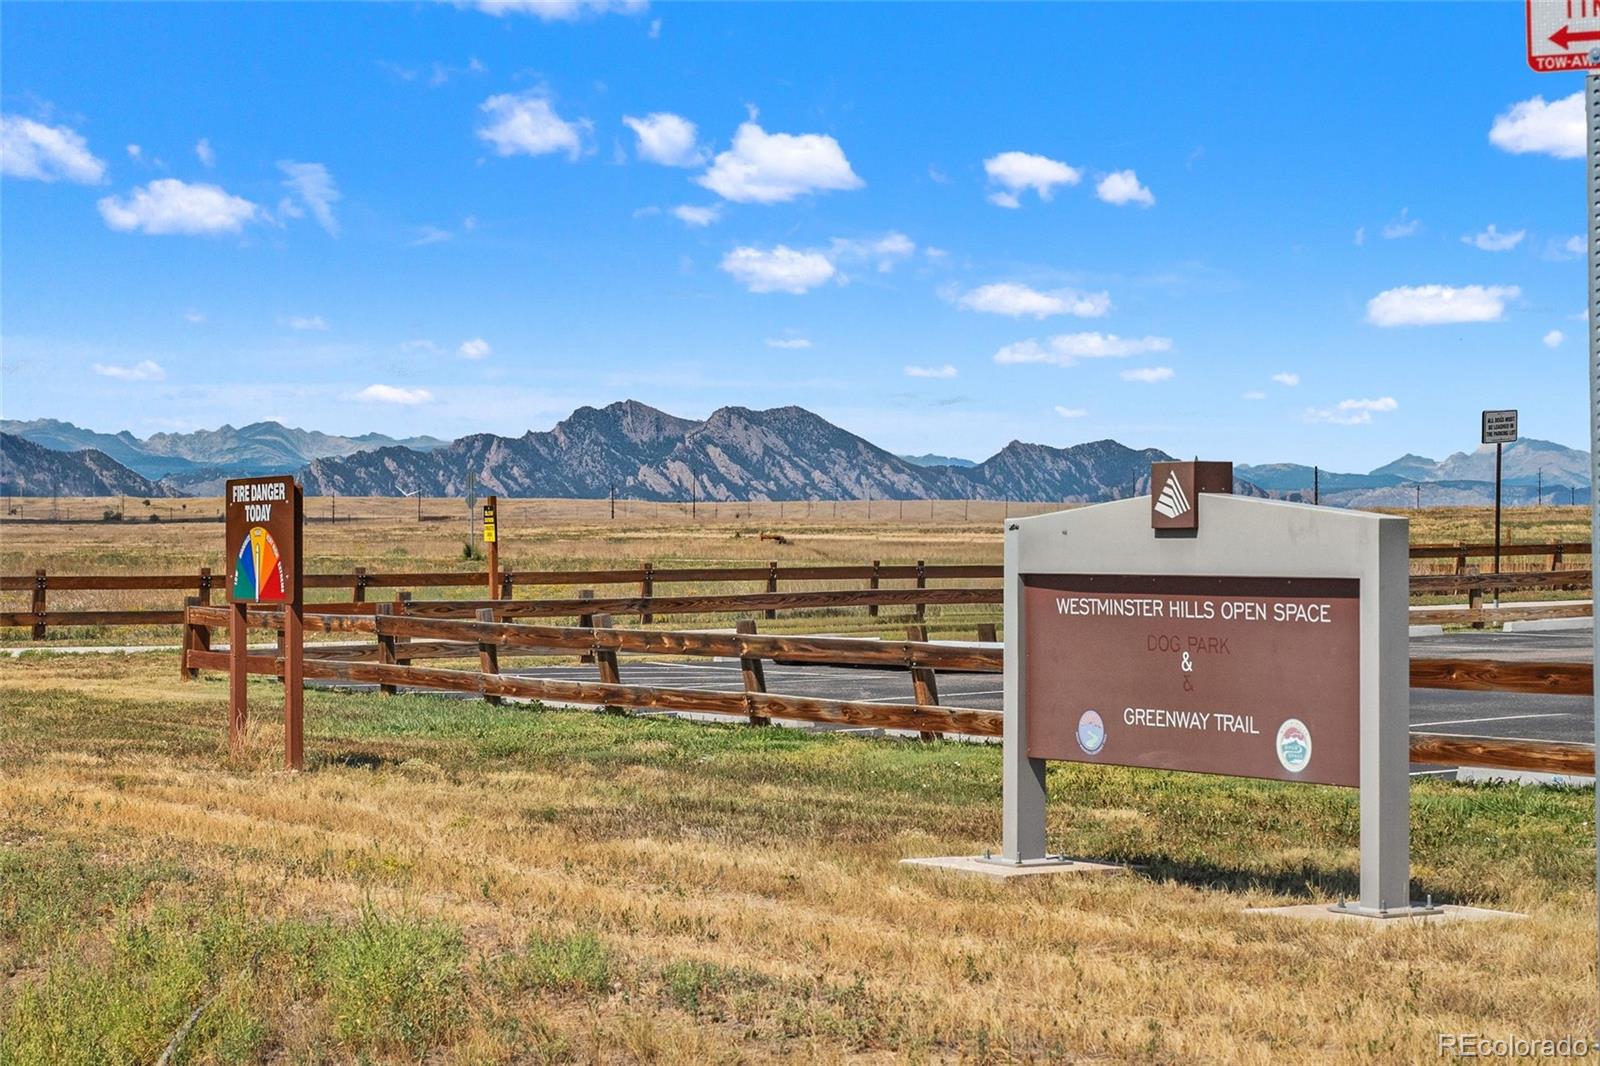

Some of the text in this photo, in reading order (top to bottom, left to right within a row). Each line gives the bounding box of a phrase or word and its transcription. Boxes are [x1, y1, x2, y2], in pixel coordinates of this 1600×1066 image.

[232, 482, 286, 503] FIRE DANGER
[244, 504, 272, 522] TODAY
[1056, 597, 1332, 623] WESTMINSTER HILLS OPEN SPACE
[1147, 634, 1231, 655] DOG PARK
[1180, 651, 1193, 672] &
[1123, 708, 1210, 731] GREENWAY
[1213, 713, 1260, 735] TRAIL
